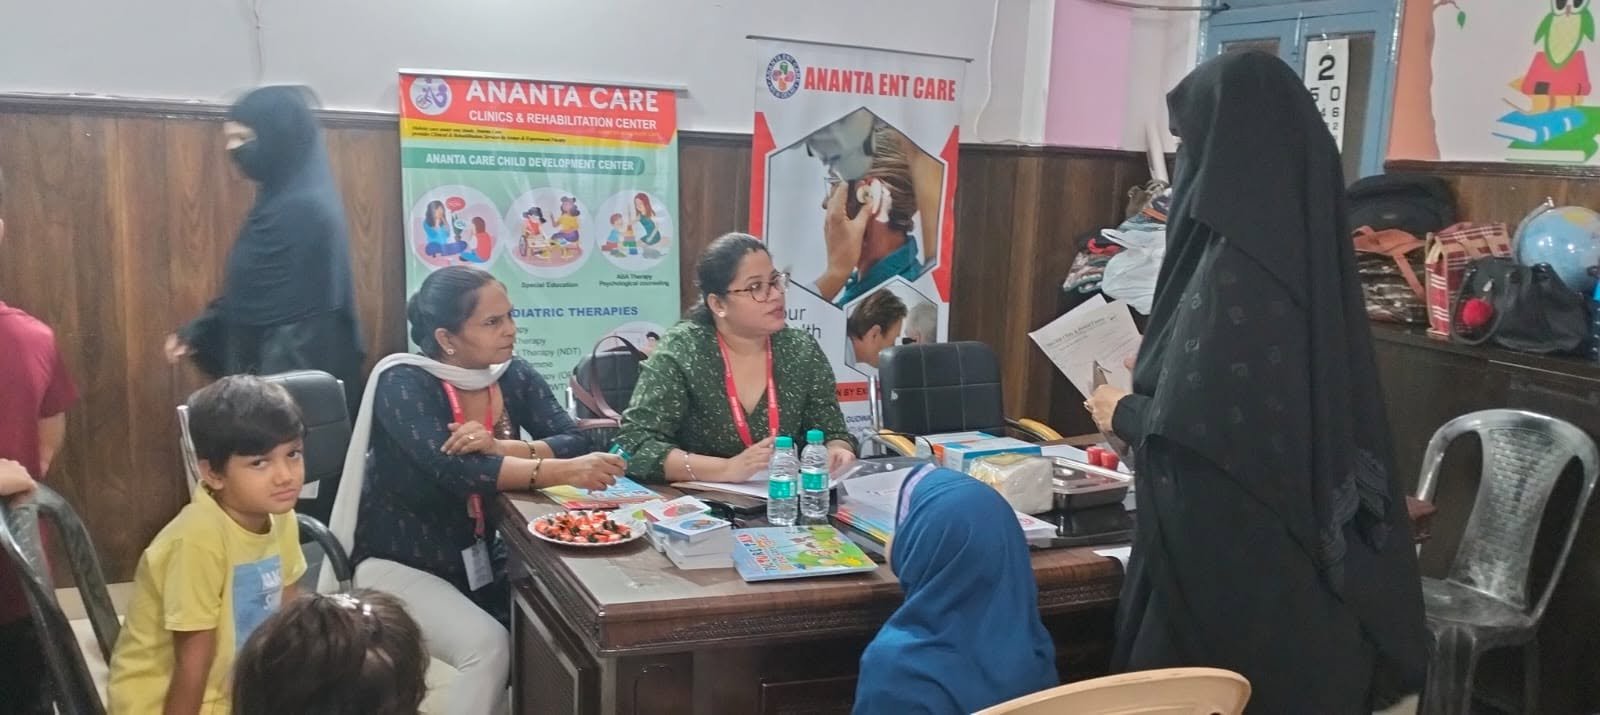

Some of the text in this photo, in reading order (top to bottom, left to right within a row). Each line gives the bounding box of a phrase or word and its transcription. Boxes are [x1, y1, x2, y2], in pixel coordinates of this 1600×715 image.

[1318, 54, 1336, 81] 2
[804, 66, 874, 95] ANANTA
[878, 72, 910, 98] ENT
[912, 75, 956, 101] CARE
[465, 79, 659, 113] ANANTA CARE
[1332, 106, 1340, 117] 6
[468, 109, 657, 130] CLINICS & REHABILITATION CENTER
[426, 152, 634, 171] ANANTA CARE CHILD DEVELOPMENT CENTER
[521, 281, 545, 289] Special
[599, 280, 638, 289] Psychological
[567, 306, 639, 317] THERAPIES
[556, 347, 582, 358] (NDT)
